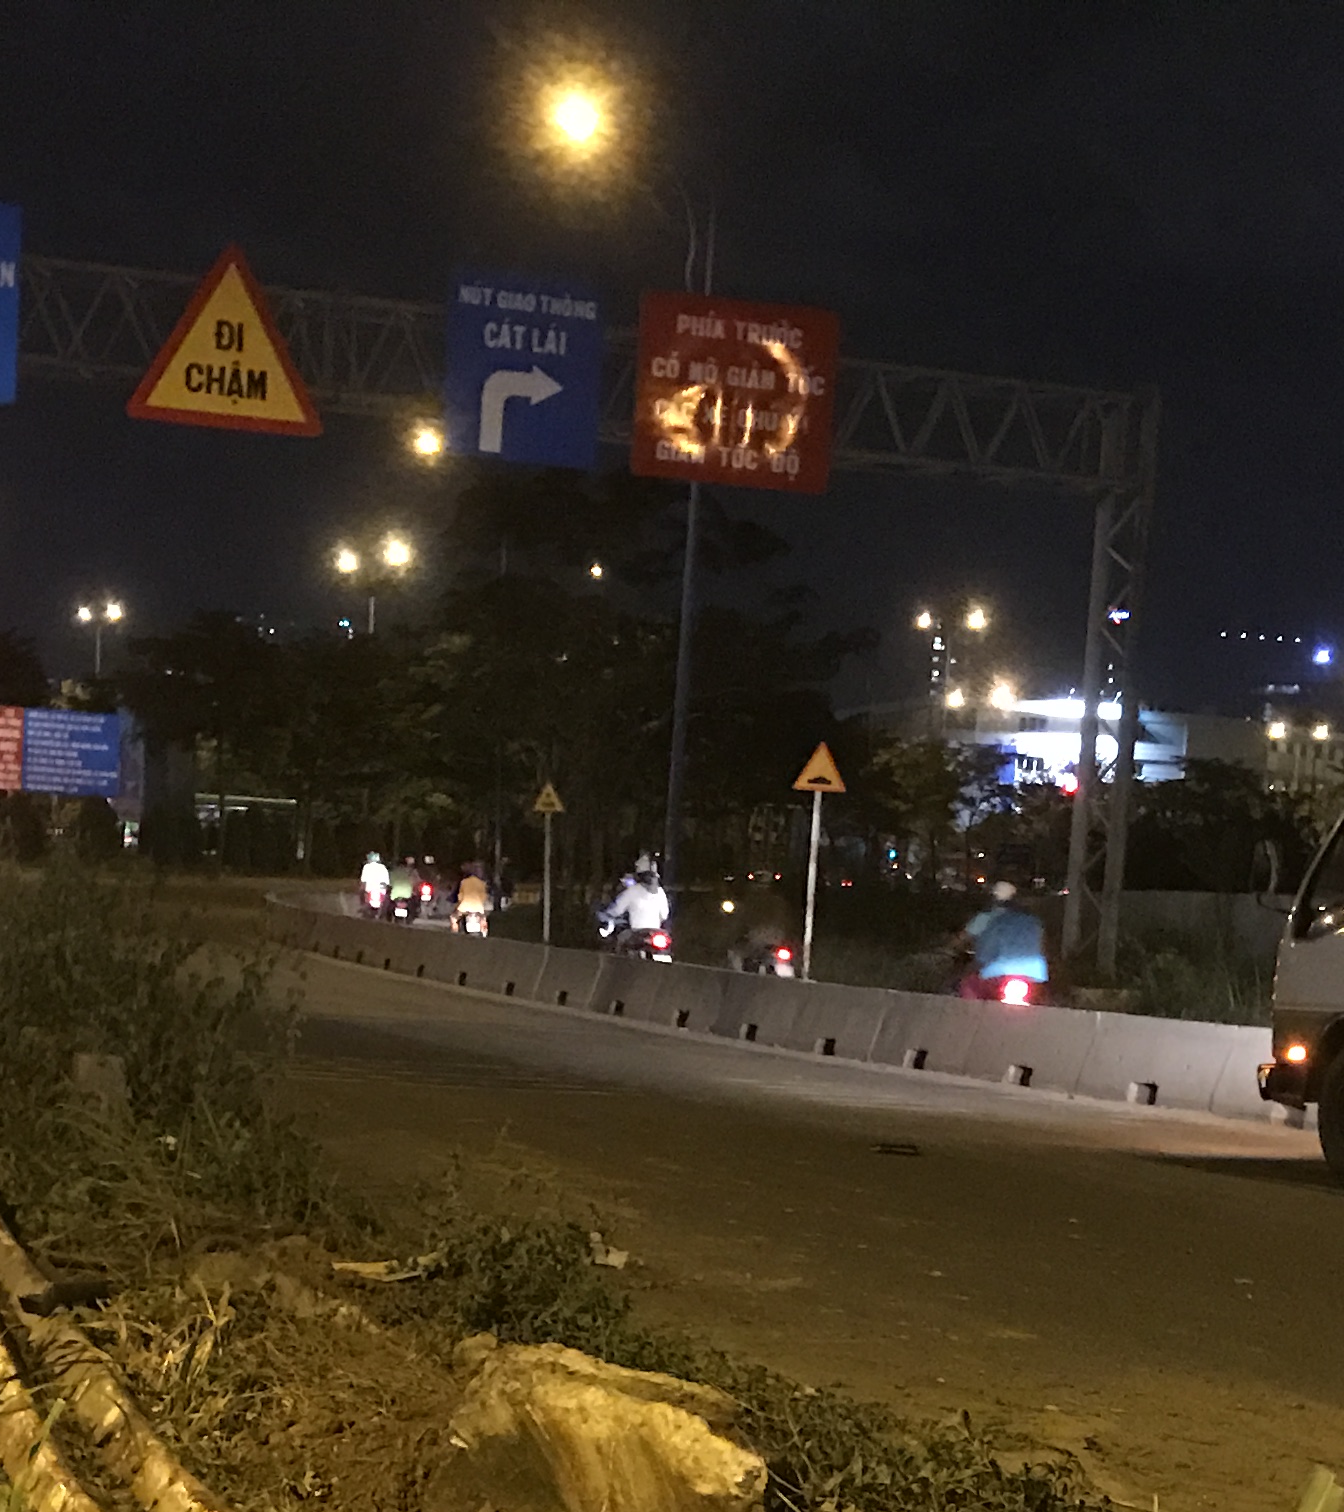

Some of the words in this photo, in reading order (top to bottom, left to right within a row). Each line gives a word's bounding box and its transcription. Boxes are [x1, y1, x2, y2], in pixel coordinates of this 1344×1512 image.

[214, 319, 244, 353] ĐI
[483, 318, 527, 351] CÁT
[531, 323, 568, 357] LÁI
[676, 310, 726, 340] PHÍA
[185, 361, 267, 405] CHẬM
